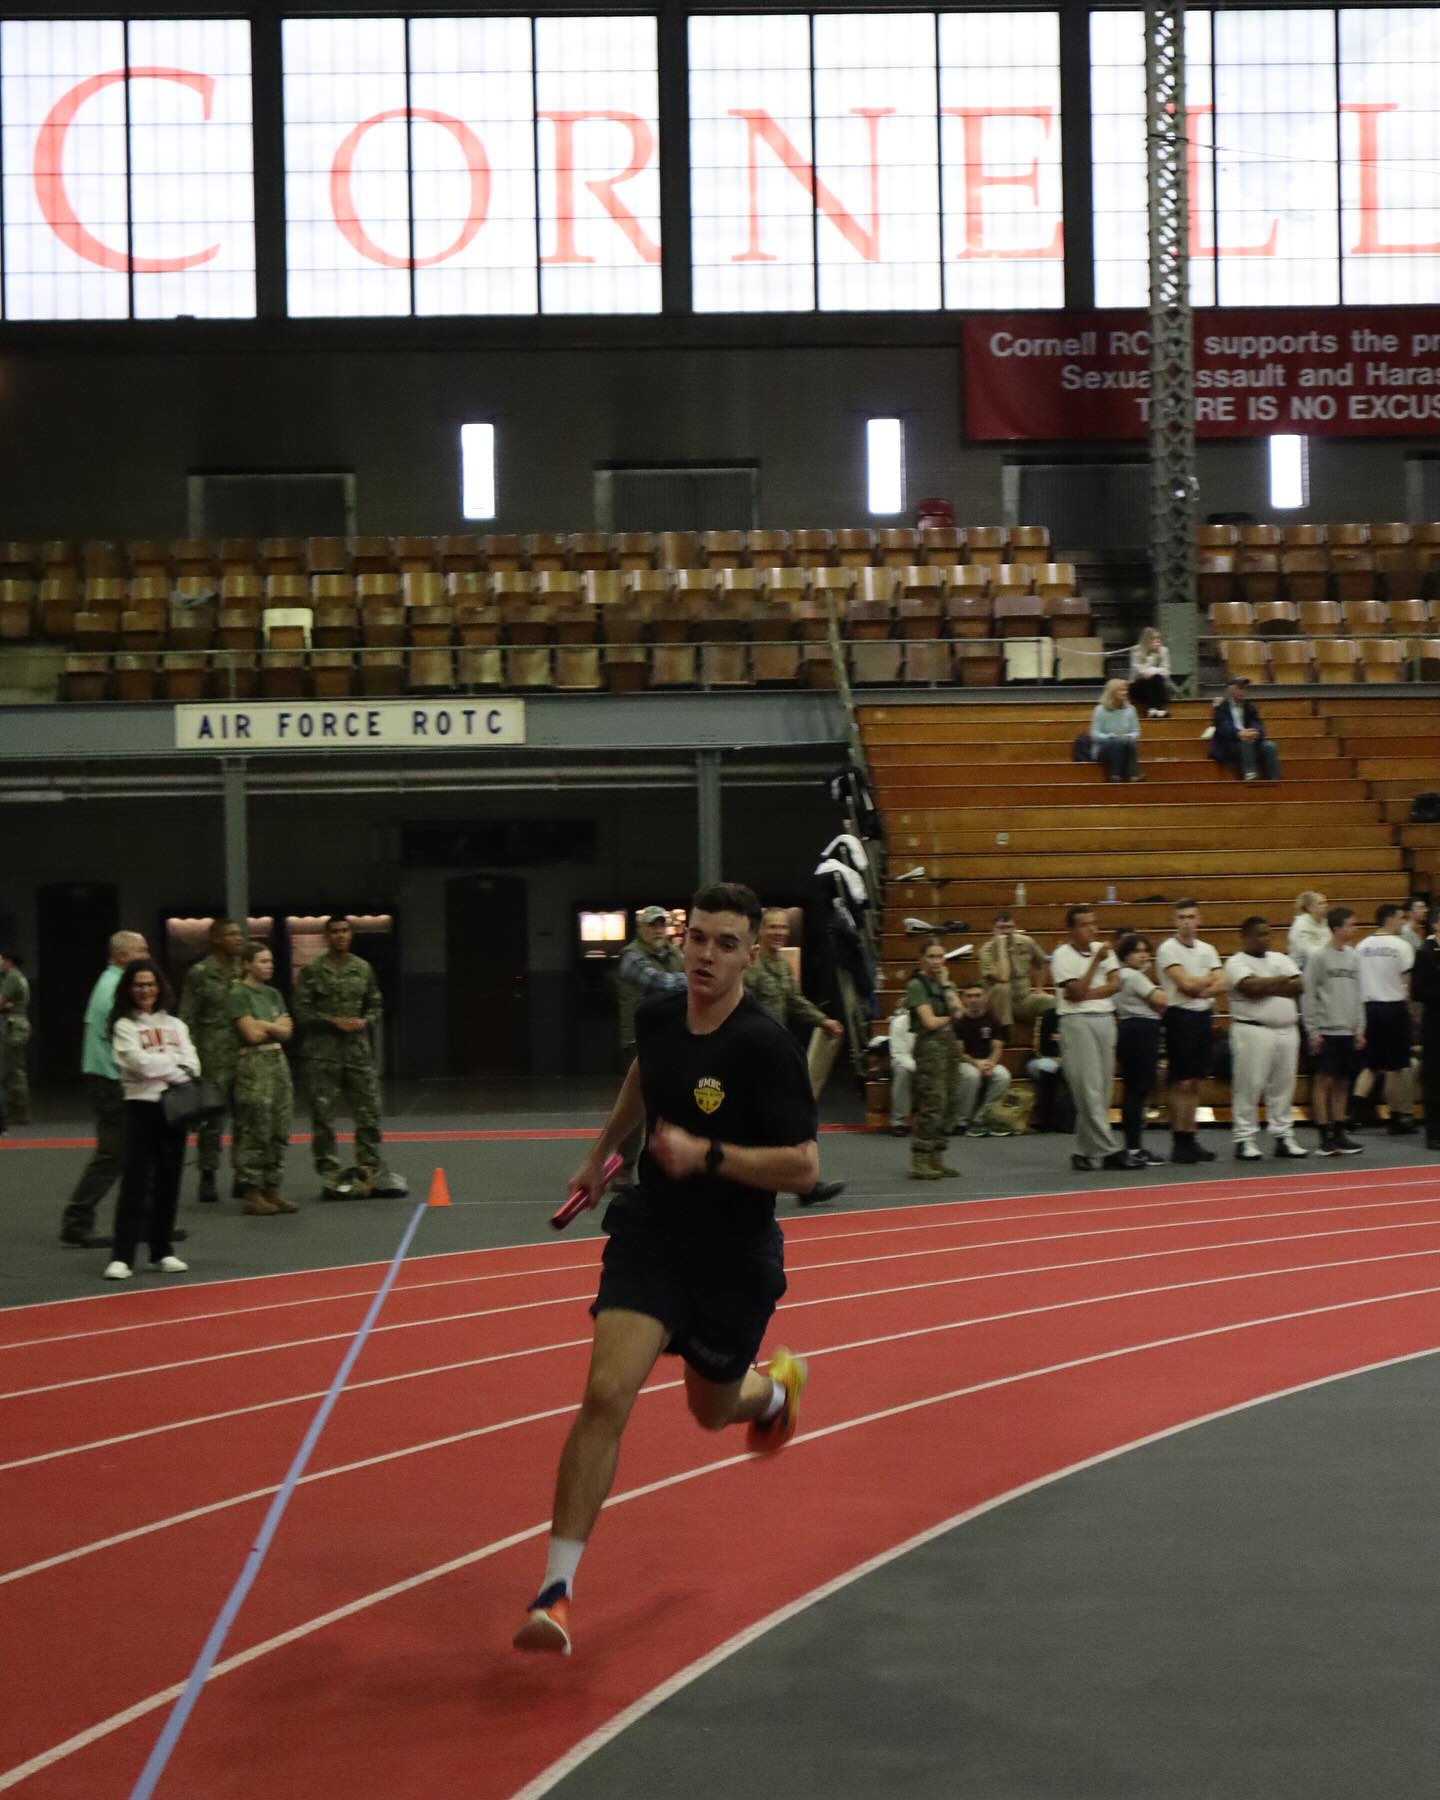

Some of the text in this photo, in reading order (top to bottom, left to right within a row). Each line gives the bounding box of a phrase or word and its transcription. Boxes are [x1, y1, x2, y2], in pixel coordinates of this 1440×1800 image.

[990, 331, 1097, 357] Cornell
[1204, 331, 1339, 358] supports
[1351, 329, 1399, 353] the
[1061, 366, 1152, 391] Sexua
[1192, 364, 1286, 389] ssault
[1299, 363, 1353, 386] and
[1135, 396, 1237, 422] TRE
[1248, 396, 1279, 421] IS
[1290, 396, 1336, 420] NO
[198, 709, 503, 738] AIR FORCE ROTC
